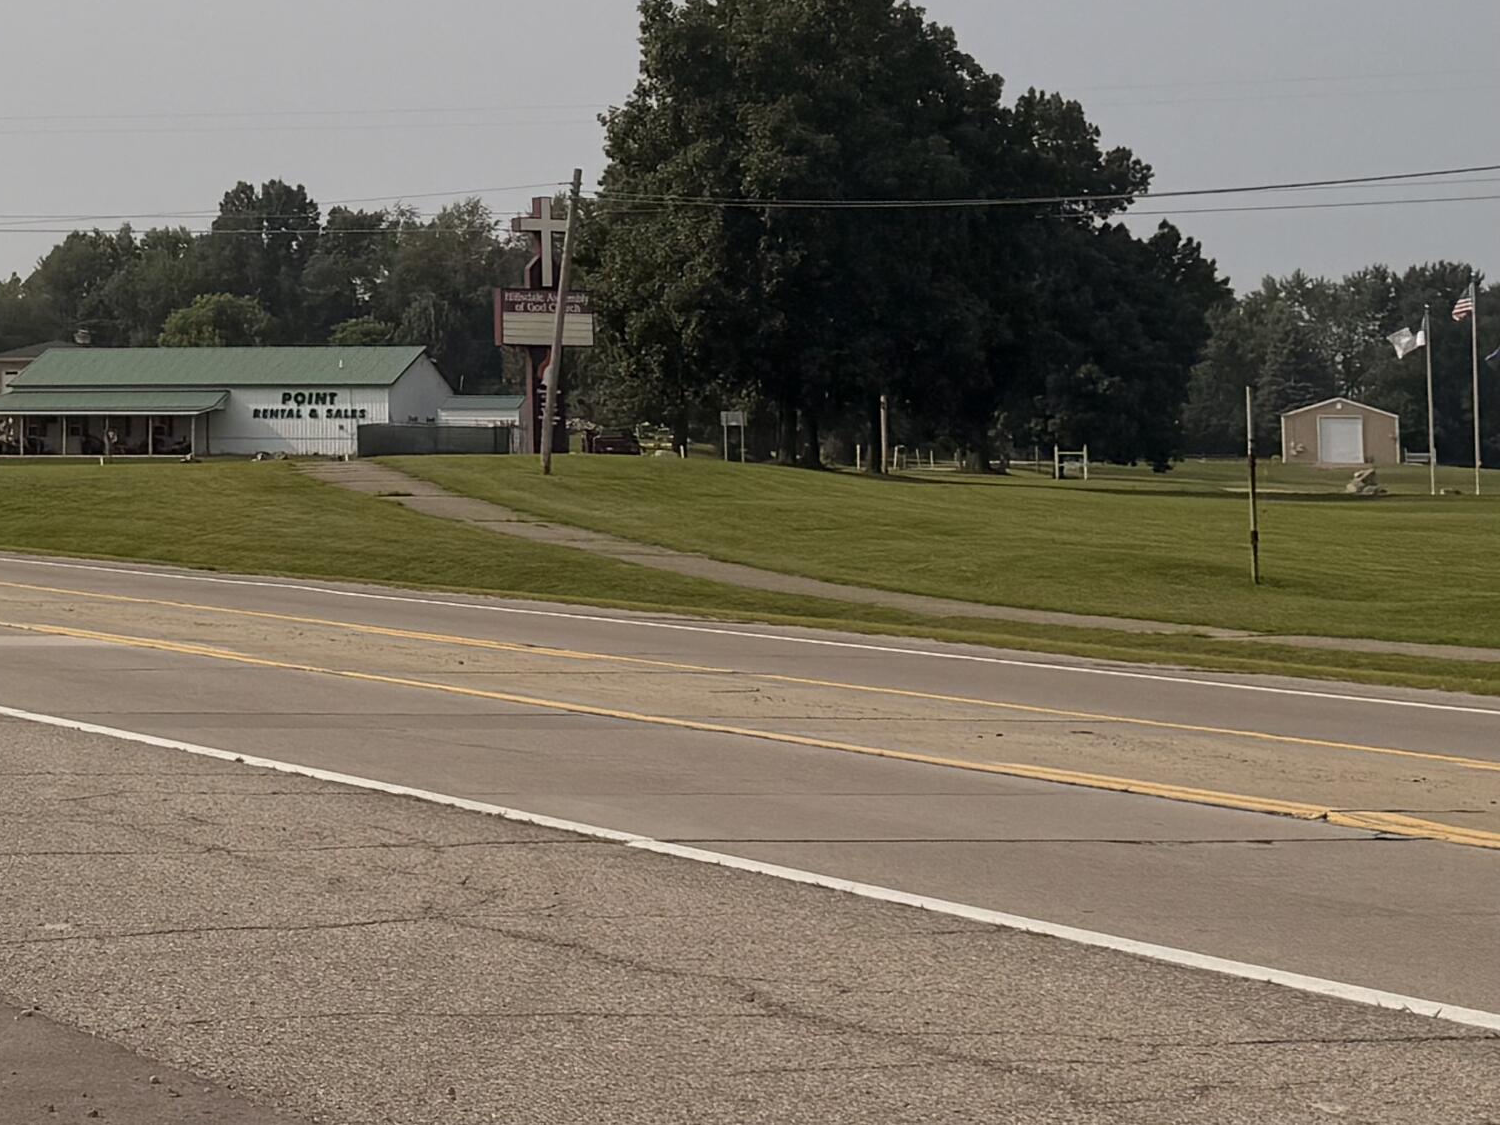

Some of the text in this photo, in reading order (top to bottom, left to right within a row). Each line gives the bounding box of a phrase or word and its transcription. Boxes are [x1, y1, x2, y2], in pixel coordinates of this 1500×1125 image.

[515, 302, 525, 312] of
[527, 302, 547, 312] God
[281, 392, 338, 405] POINT
[252, 408, 367, 419] RENTAL & SALES
